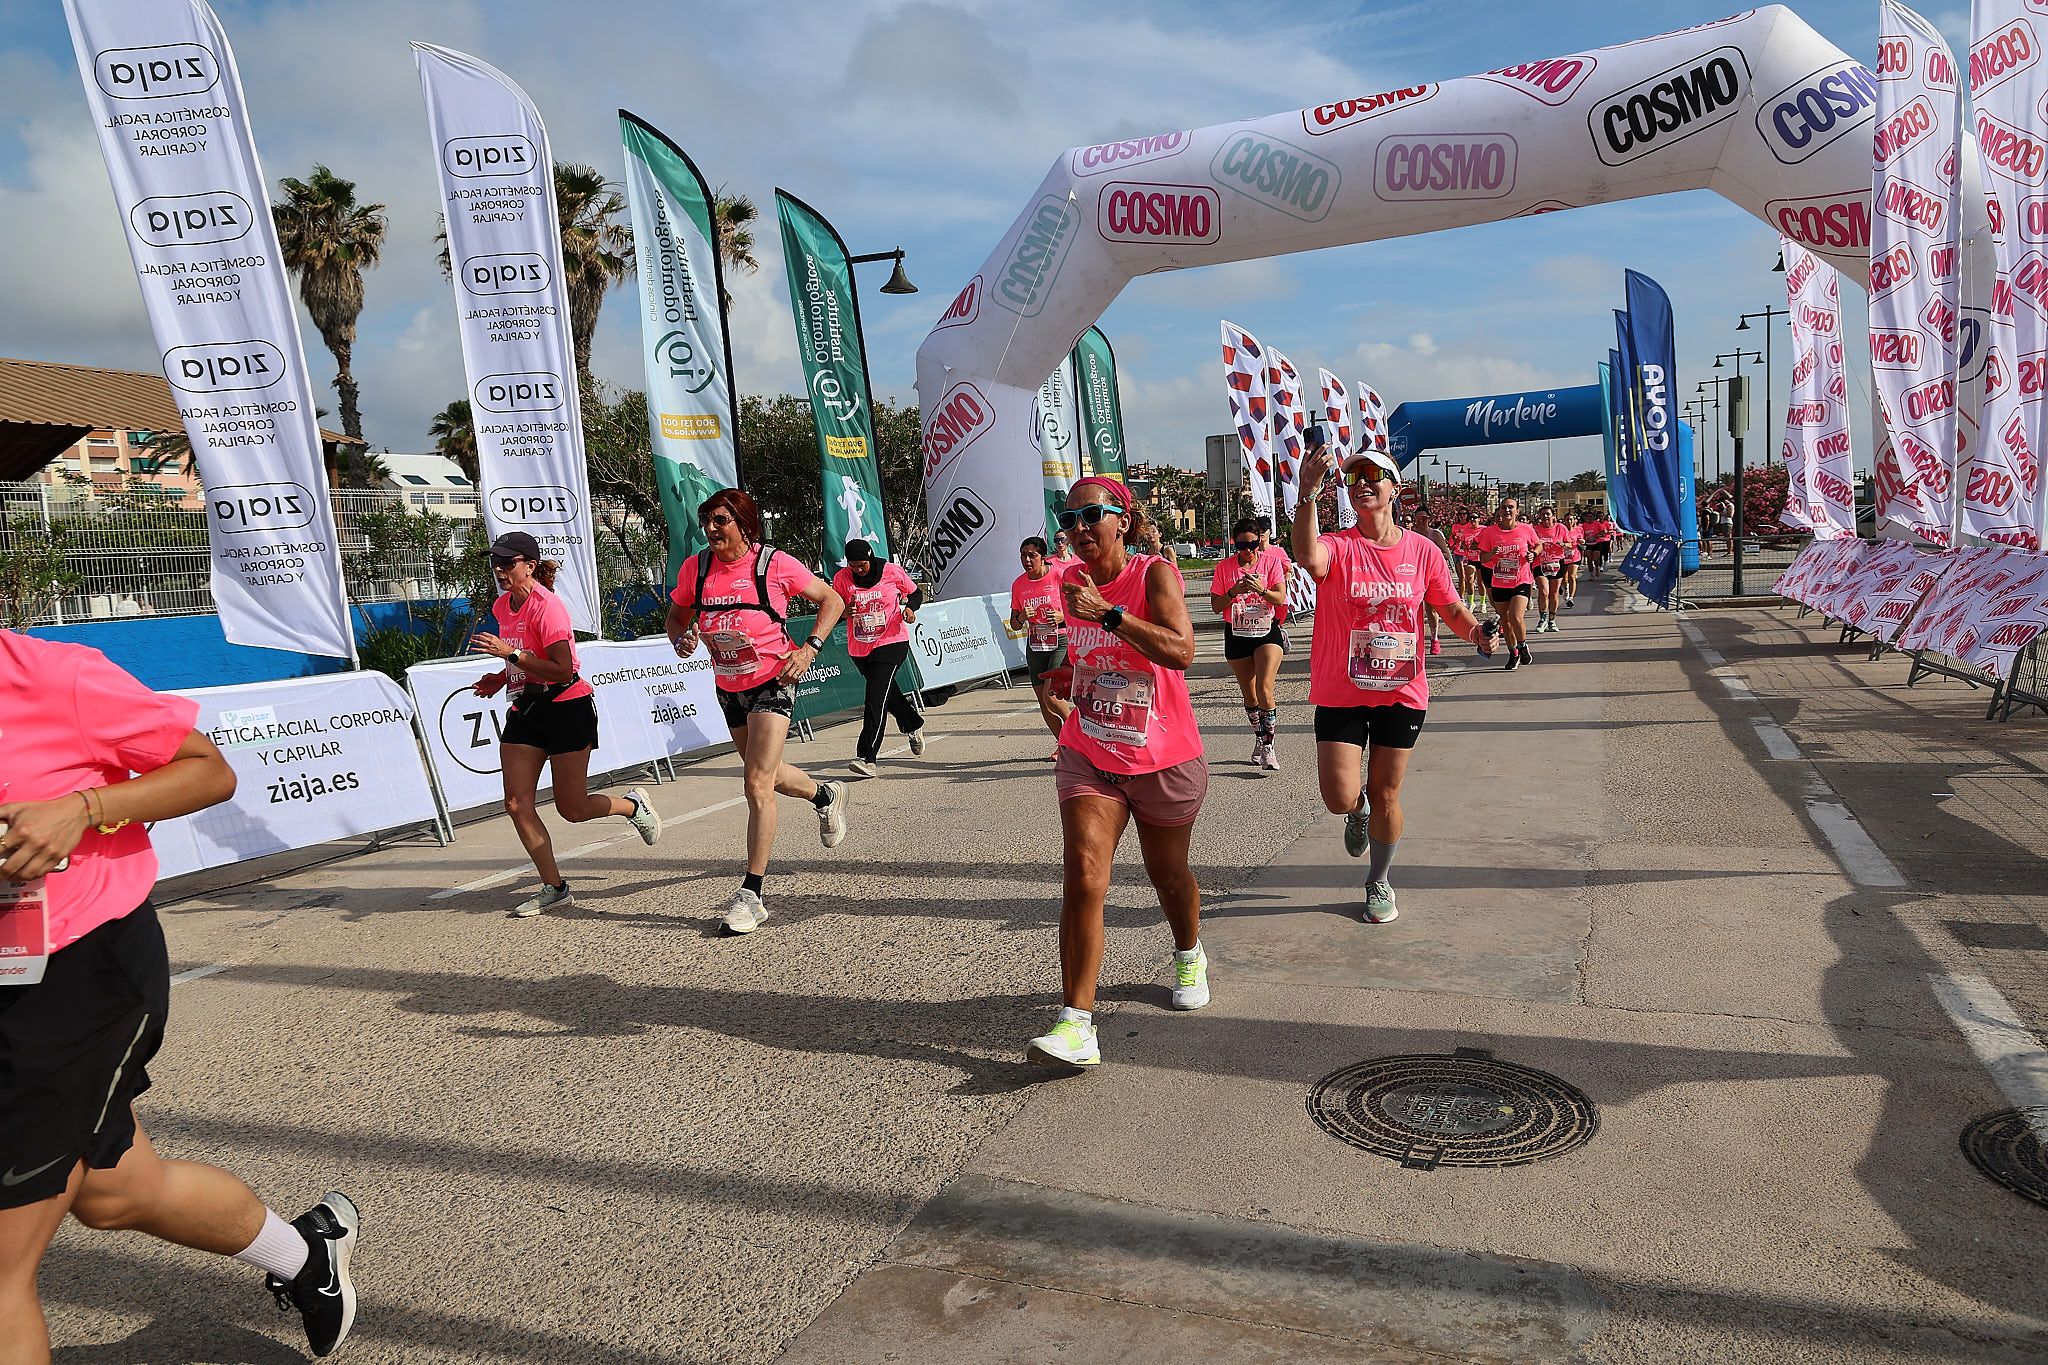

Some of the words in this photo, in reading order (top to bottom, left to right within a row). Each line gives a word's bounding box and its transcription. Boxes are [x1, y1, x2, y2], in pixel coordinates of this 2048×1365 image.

[1603, 58, 1738, 153] COSMO
[1772, 66, 1876, 149] COSM
[1222, 138, 1329, 212] COSMO
[1386, 143, 1505, 191] COSMO
[1108, 190, 1210, 237] COSMO
[1778, 203, 1872, 248] COSM
[1000, 204, 1070, 305] COSMO
[1465, 397, 1556, 437] Marlene
[1351, 582, 1414, 598] CARRERA
[720, 650, 738, 659] 016
[1371, 659, 1396, 669] 016
[510, 672, 526, 683] 016
[592, 668, 646, 687] COSMÉTICA
[644, 685, 651, 696] Y
[652, 682, 686, 696] CAPILAR
[650, 702, 697, 724] ziaja.es
[1092, 701, 1122, 716] 016
[267, 718, 328, 740] FACIAL,
[257, 752, 269, 766] Y
[274, 741, 342, 764] CAPILAR
[266, 770, 360, 804] ziaja.es
